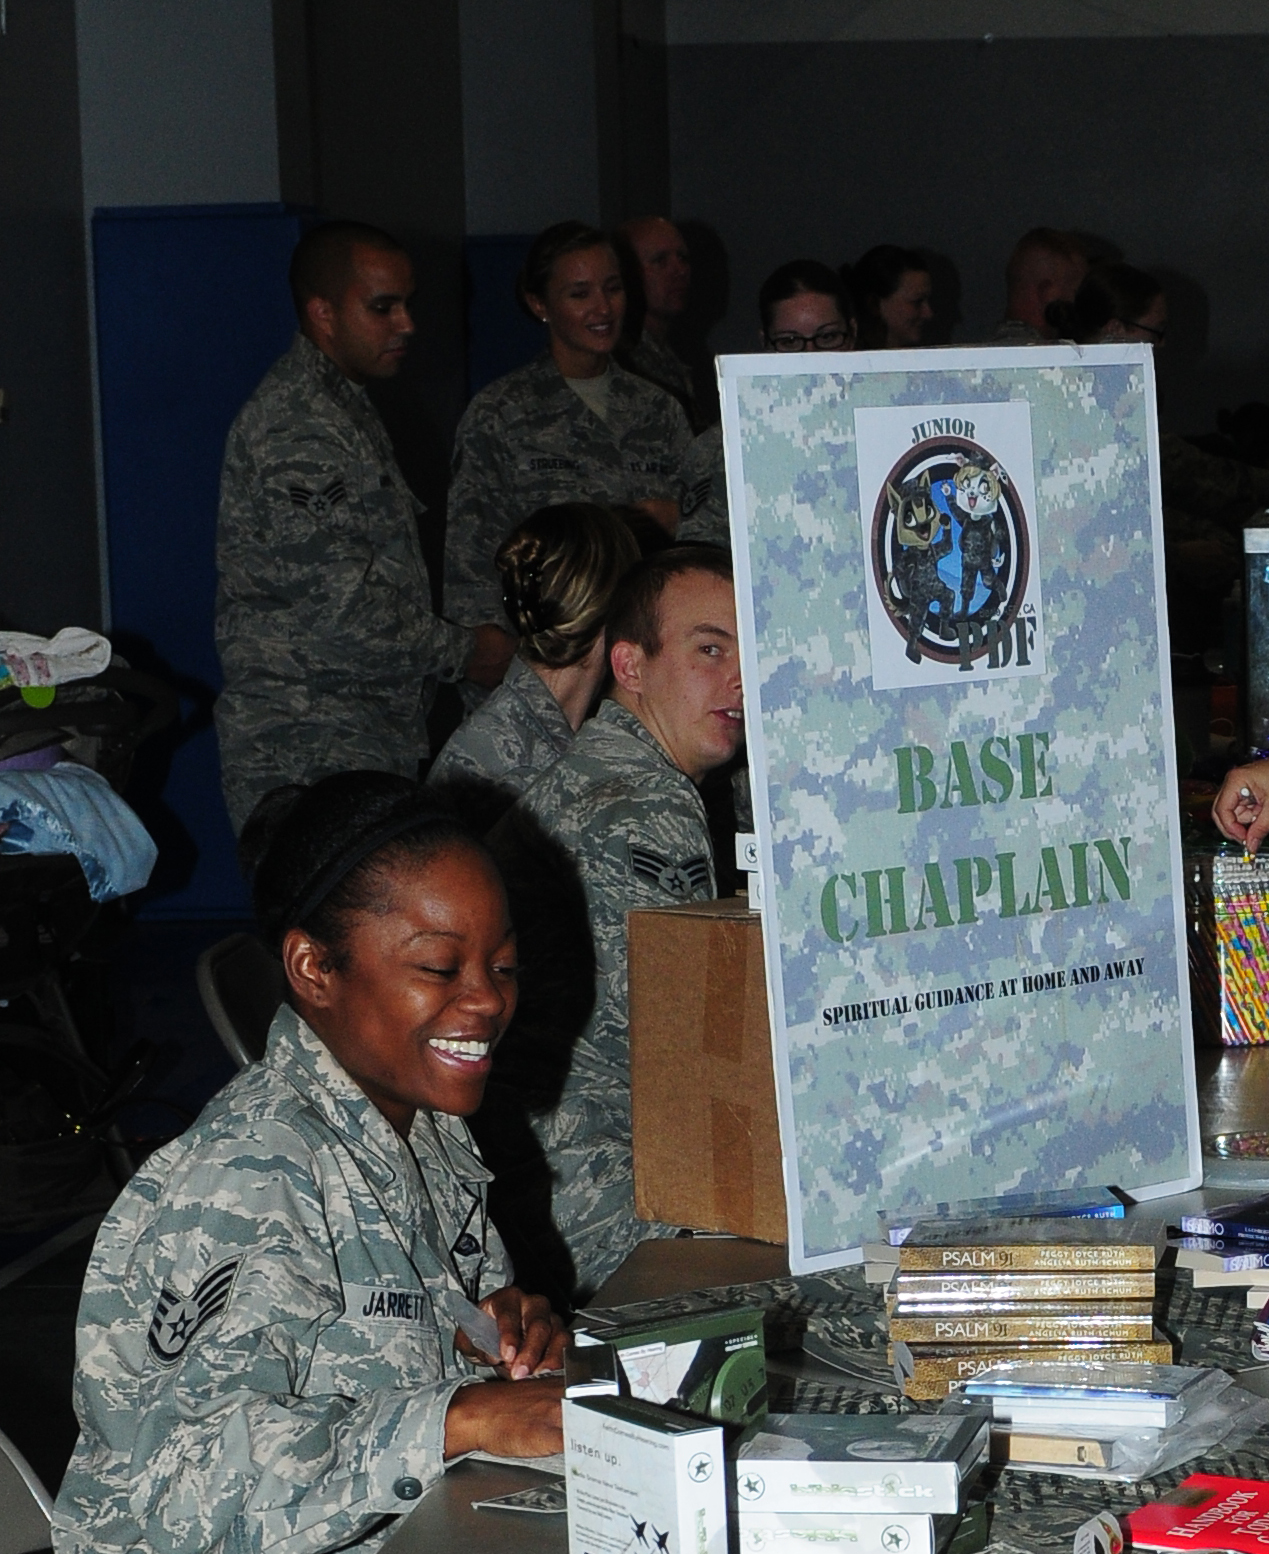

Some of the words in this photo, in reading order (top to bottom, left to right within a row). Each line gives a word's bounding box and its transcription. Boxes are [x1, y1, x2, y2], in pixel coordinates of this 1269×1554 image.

[911, 416, 976, 444] JUNIOR
[1022, 603, 1036, 615] CA
[956, 615, 1038, 673] PDF
[892, 731, 1054, 815] BASE
[819, 836, 1133, 944] CHAPLAIN
[822, 997, 912, 1027] SPIRITUAL
[914, 982, 995, 1011] GUIDANCE
[998, 977, 1019, 998] AT
[1022, 970, 1067, 993] HOME
[1069, 965, 1101, 987] AND
[1103, 957, 1146, 981] AWAY
[942, 1251, 995, 1267] PSALM
[999, 1251, 1013, 1267] 91
[1040, 1250, 1069, 1259] PEGGY
[1071, 1250, 1099, 1259] JOYCE
[1101, 1250, 1125, 1259] RUTH
[1075, 1258, 1099, 1267] RUTH
[1101, 1258, 1133, 1267] SCHUM
[941, 1281, 994, 1294] PSALM
[935, 1323, 989, 1338] PSALM
[993, 1323, 1008, 1338] 91
[1071, 1329, 1095, 1338] RUTH
[1058, 1353, 1087, 1363] PEGGY
[1089, 1352, 1116, 1362] JOYCE
[1118, 1350, 1143, 1361] RUTH
[570, 1438, 600, 1460] listen
[604, 1451, 622, 1467] up.
[1166, 1490, 1259, 1539] HANDBOOK
[1223, 1510, 1260, 1525] FOR
